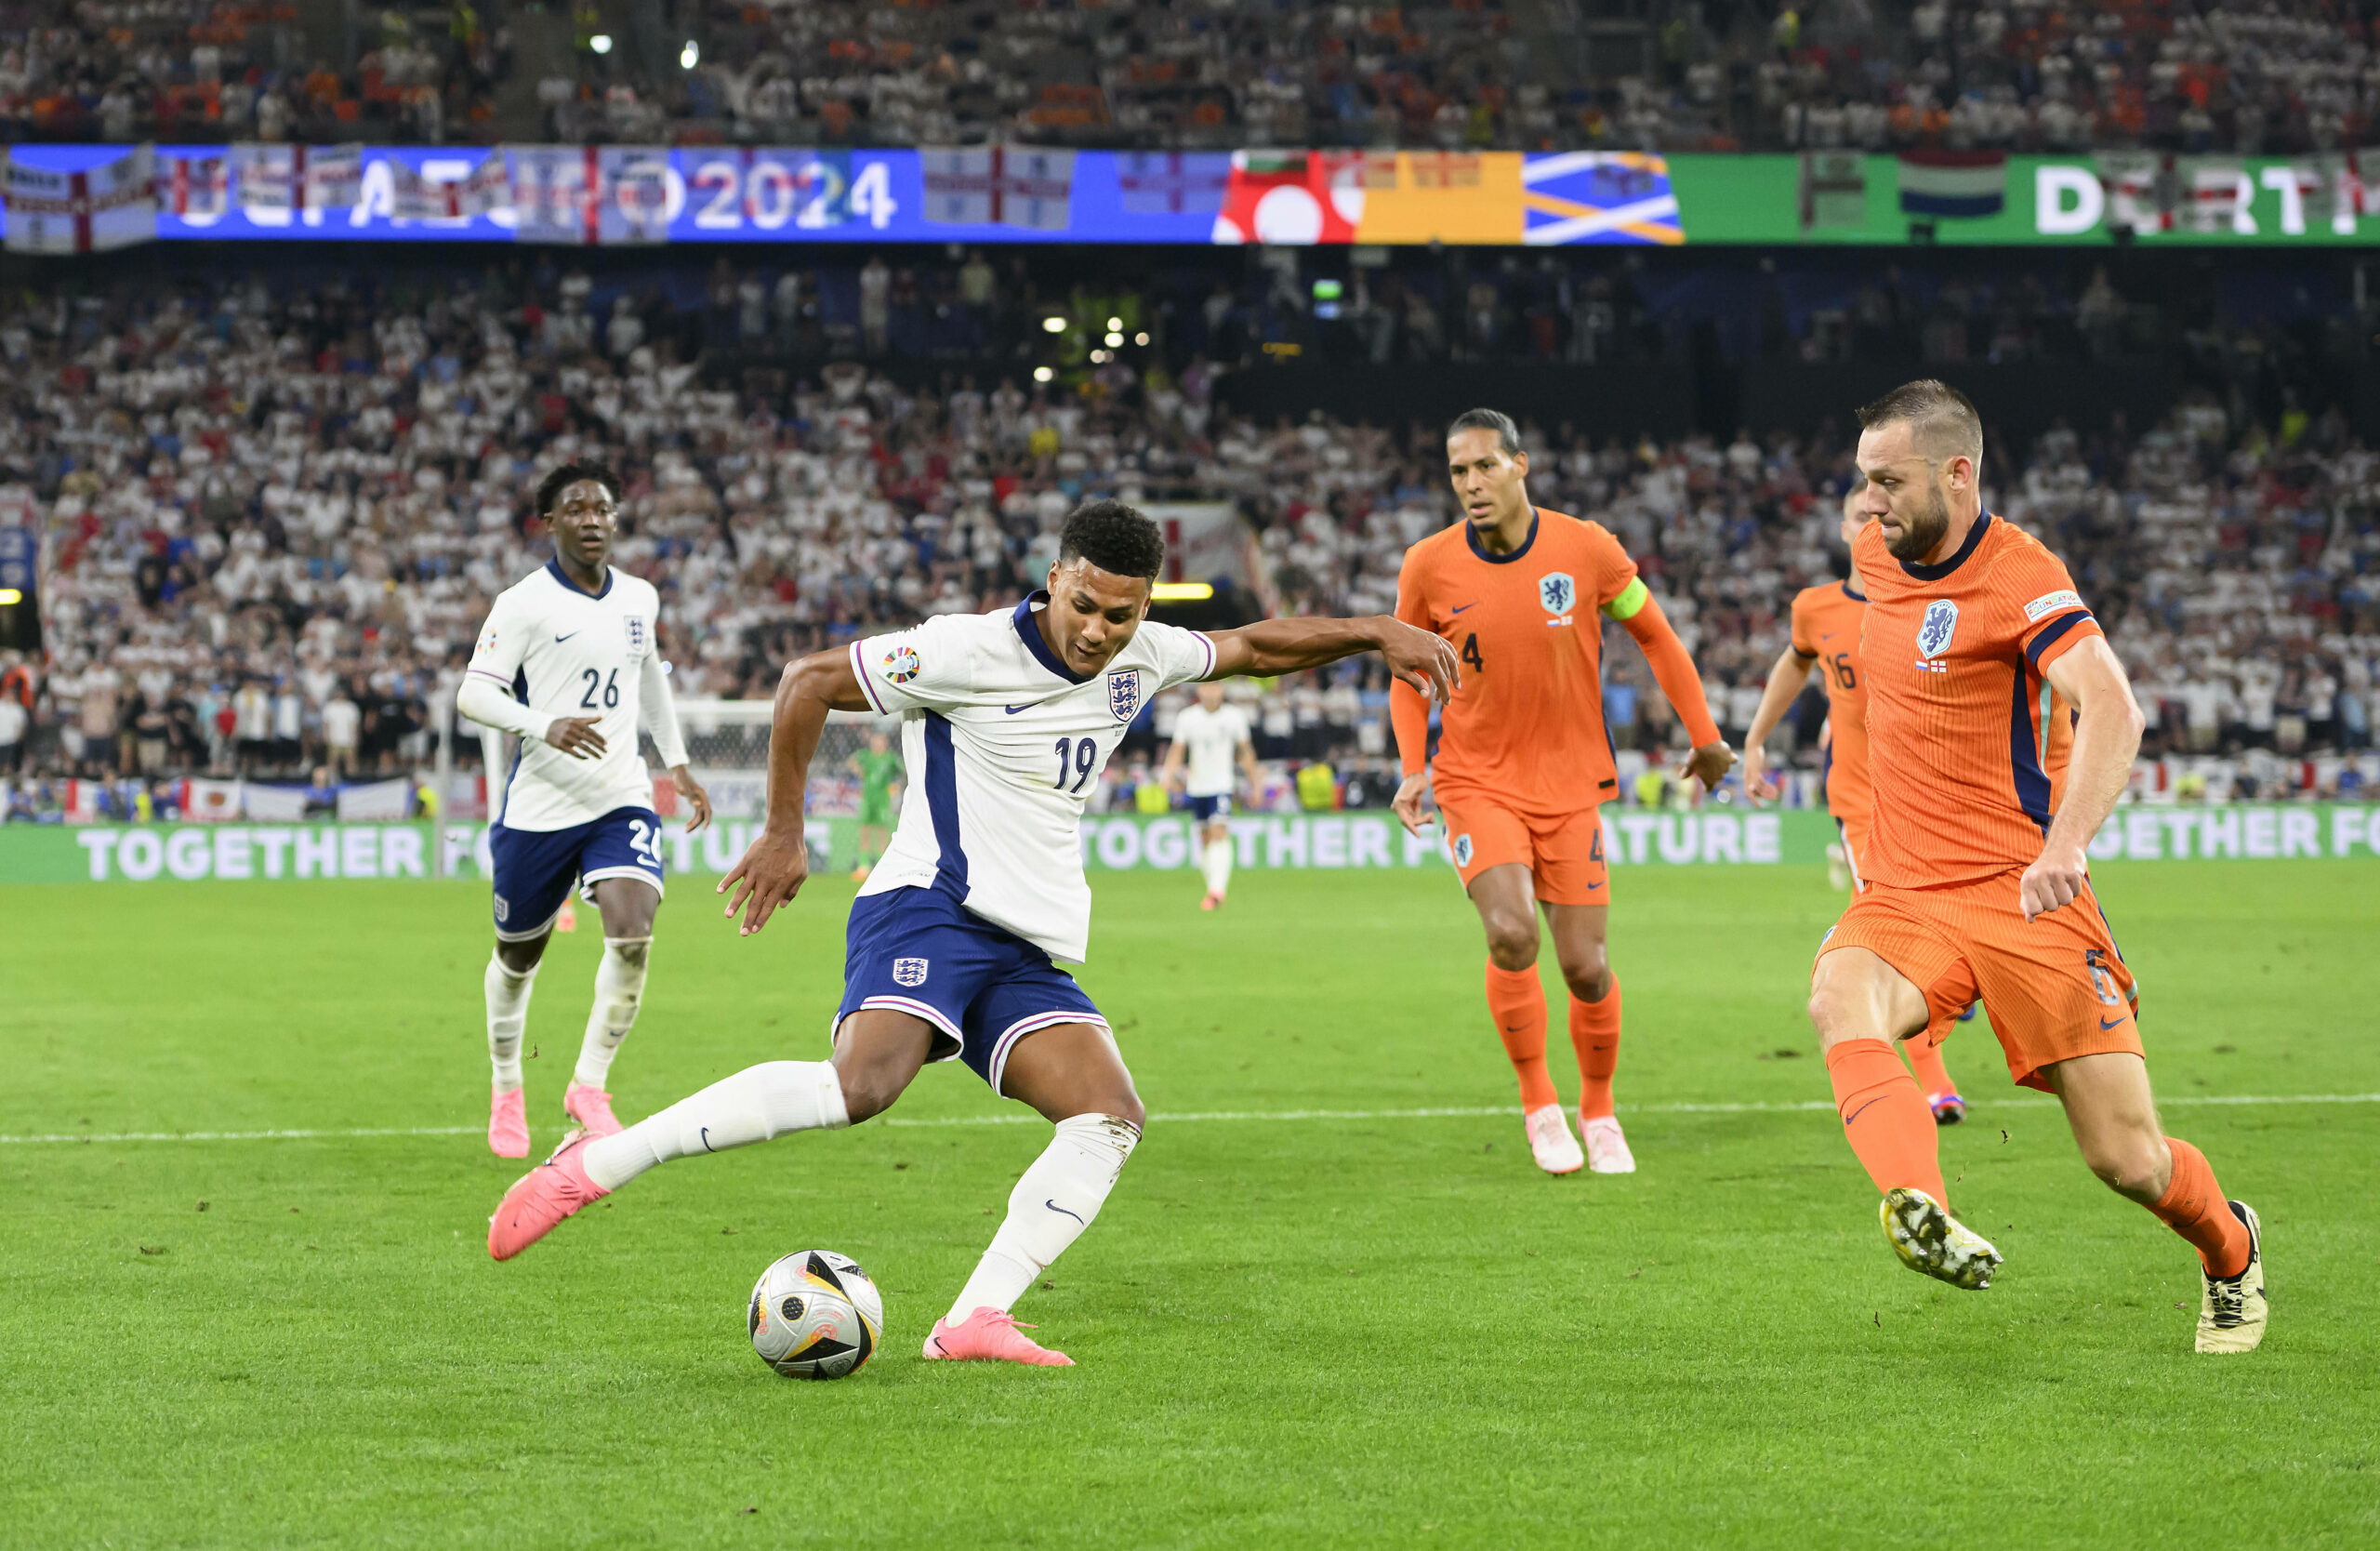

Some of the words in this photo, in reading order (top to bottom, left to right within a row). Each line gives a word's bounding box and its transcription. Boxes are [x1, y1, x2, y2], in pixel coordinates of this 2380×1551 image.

[694, 162, 897, 230] 2024
[1462, 633, 1483, 672] 4
[1827, 653, 1856, 689] 16
[580, 668, 619, 709] 26
[1054, 737, 1096, 794] 19
[76, 828, 424, 881] TOGETHER
[1589, 829, 1605, 871] 4
[2085, 949, 2119, 1006] 6
